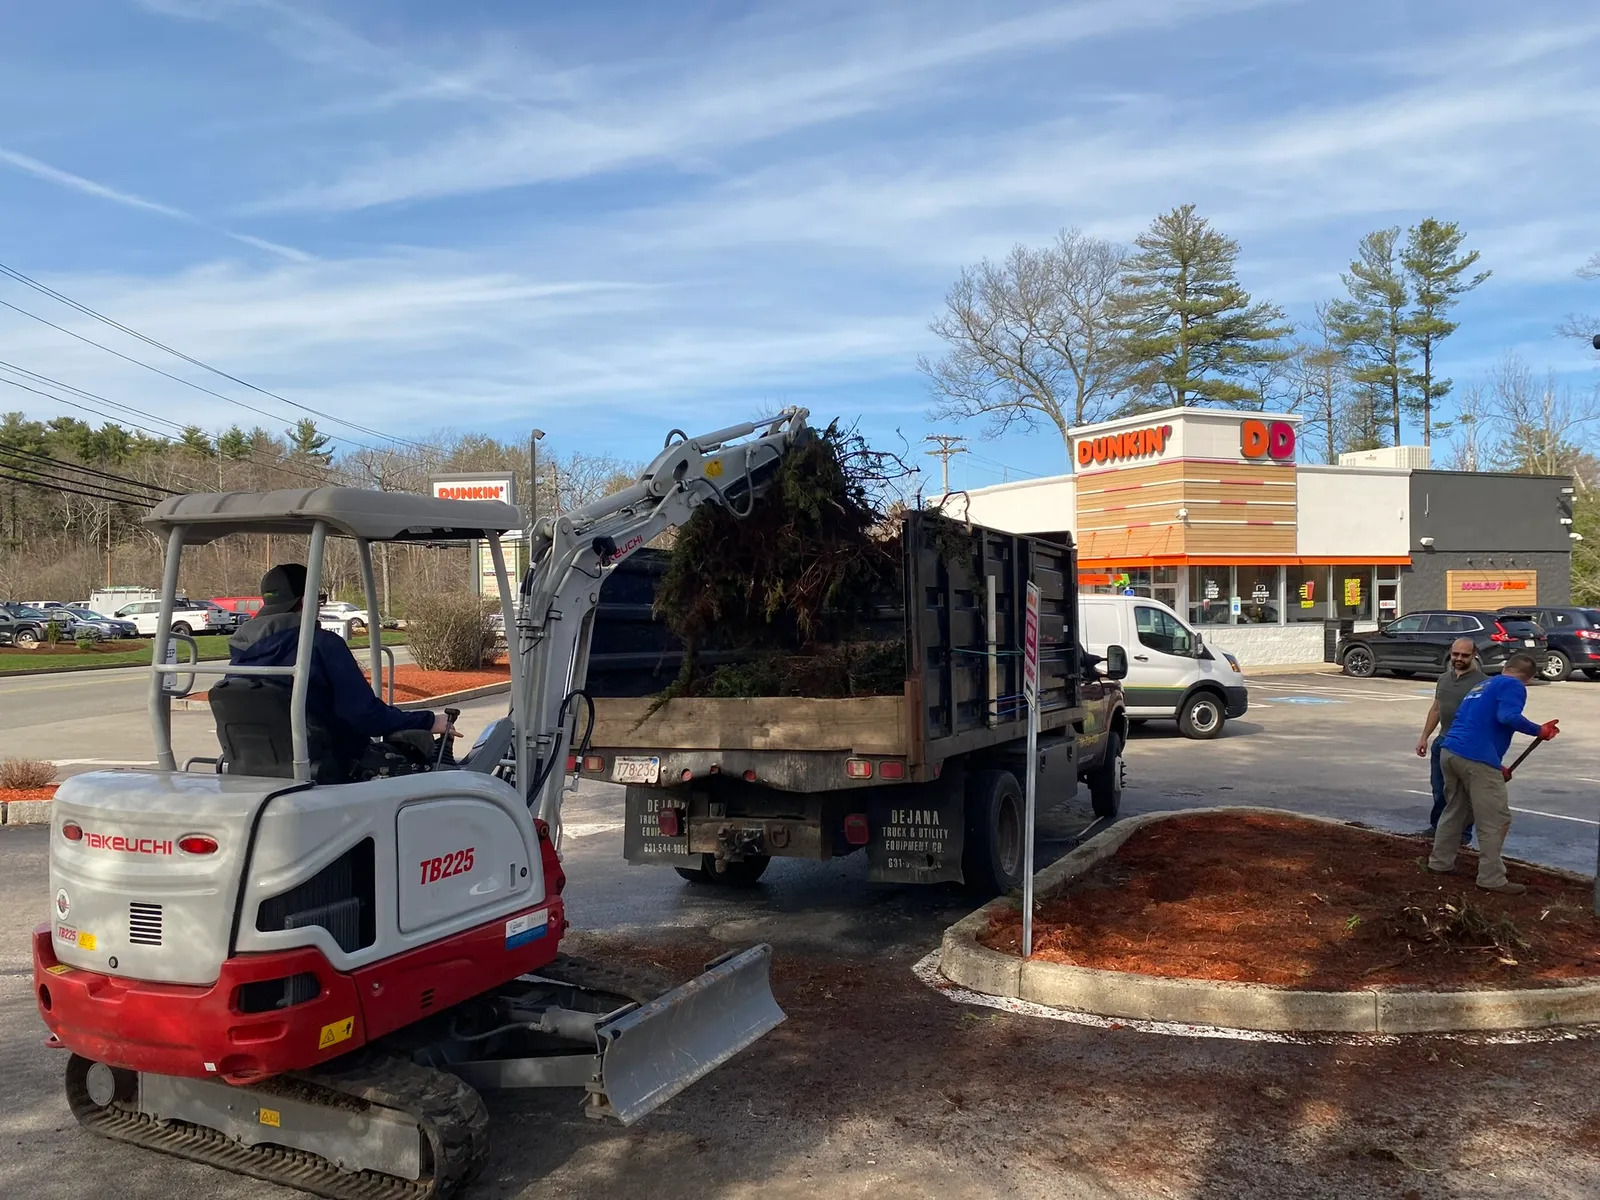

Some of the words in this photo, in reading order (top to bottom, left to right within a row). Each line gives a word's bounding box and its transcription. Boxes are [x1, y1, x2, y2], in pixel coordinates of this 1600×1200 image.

[1077, 424, 1171, 465] DUNKIN'
[1241, 419, 1296, 459] DD
[891, 809, 940, 826] DEJANA
[882, 826, 907, 838] TRUCK
[909, 827, 916, 838] &
[918, 827, 949, 839] UTILITY
[885, 840, 929, 851] EQUIPMENT
[419, 847, 475, 886] TB225
[58, 926, 77, 941] TB225
